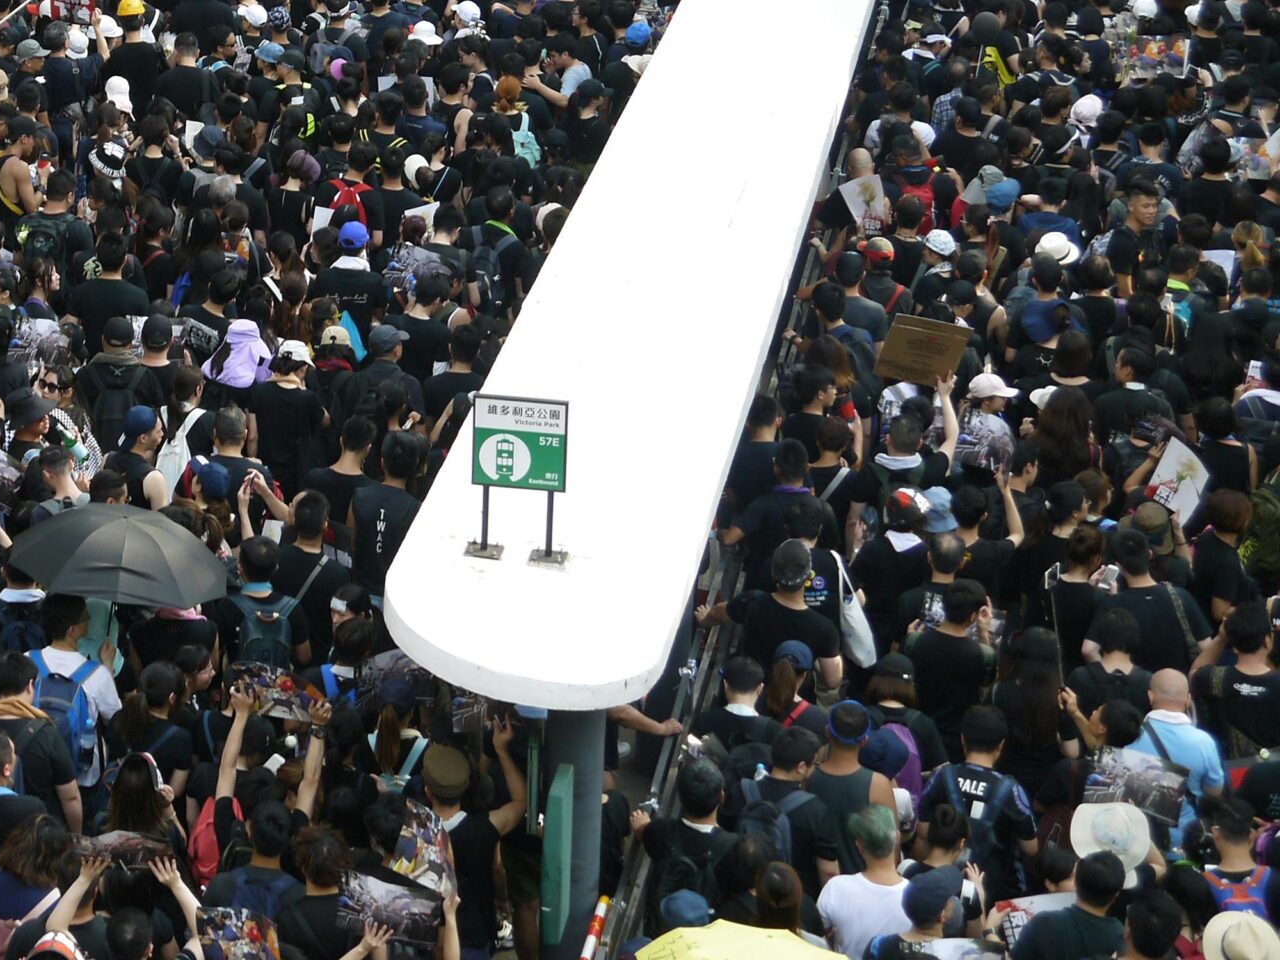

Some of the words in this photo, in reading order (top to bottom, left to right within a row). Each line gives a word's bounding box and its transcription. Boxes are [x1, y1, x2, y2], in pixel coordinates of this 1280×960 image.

[487, 403, 561, 420] 維多利亞公園
[514, 418, 542, 427] Victoria
[538, 436, 560, 447] 57E
[528, 478, 559, 486] Eastbound
[376, 508, 386, 553] TWAC
